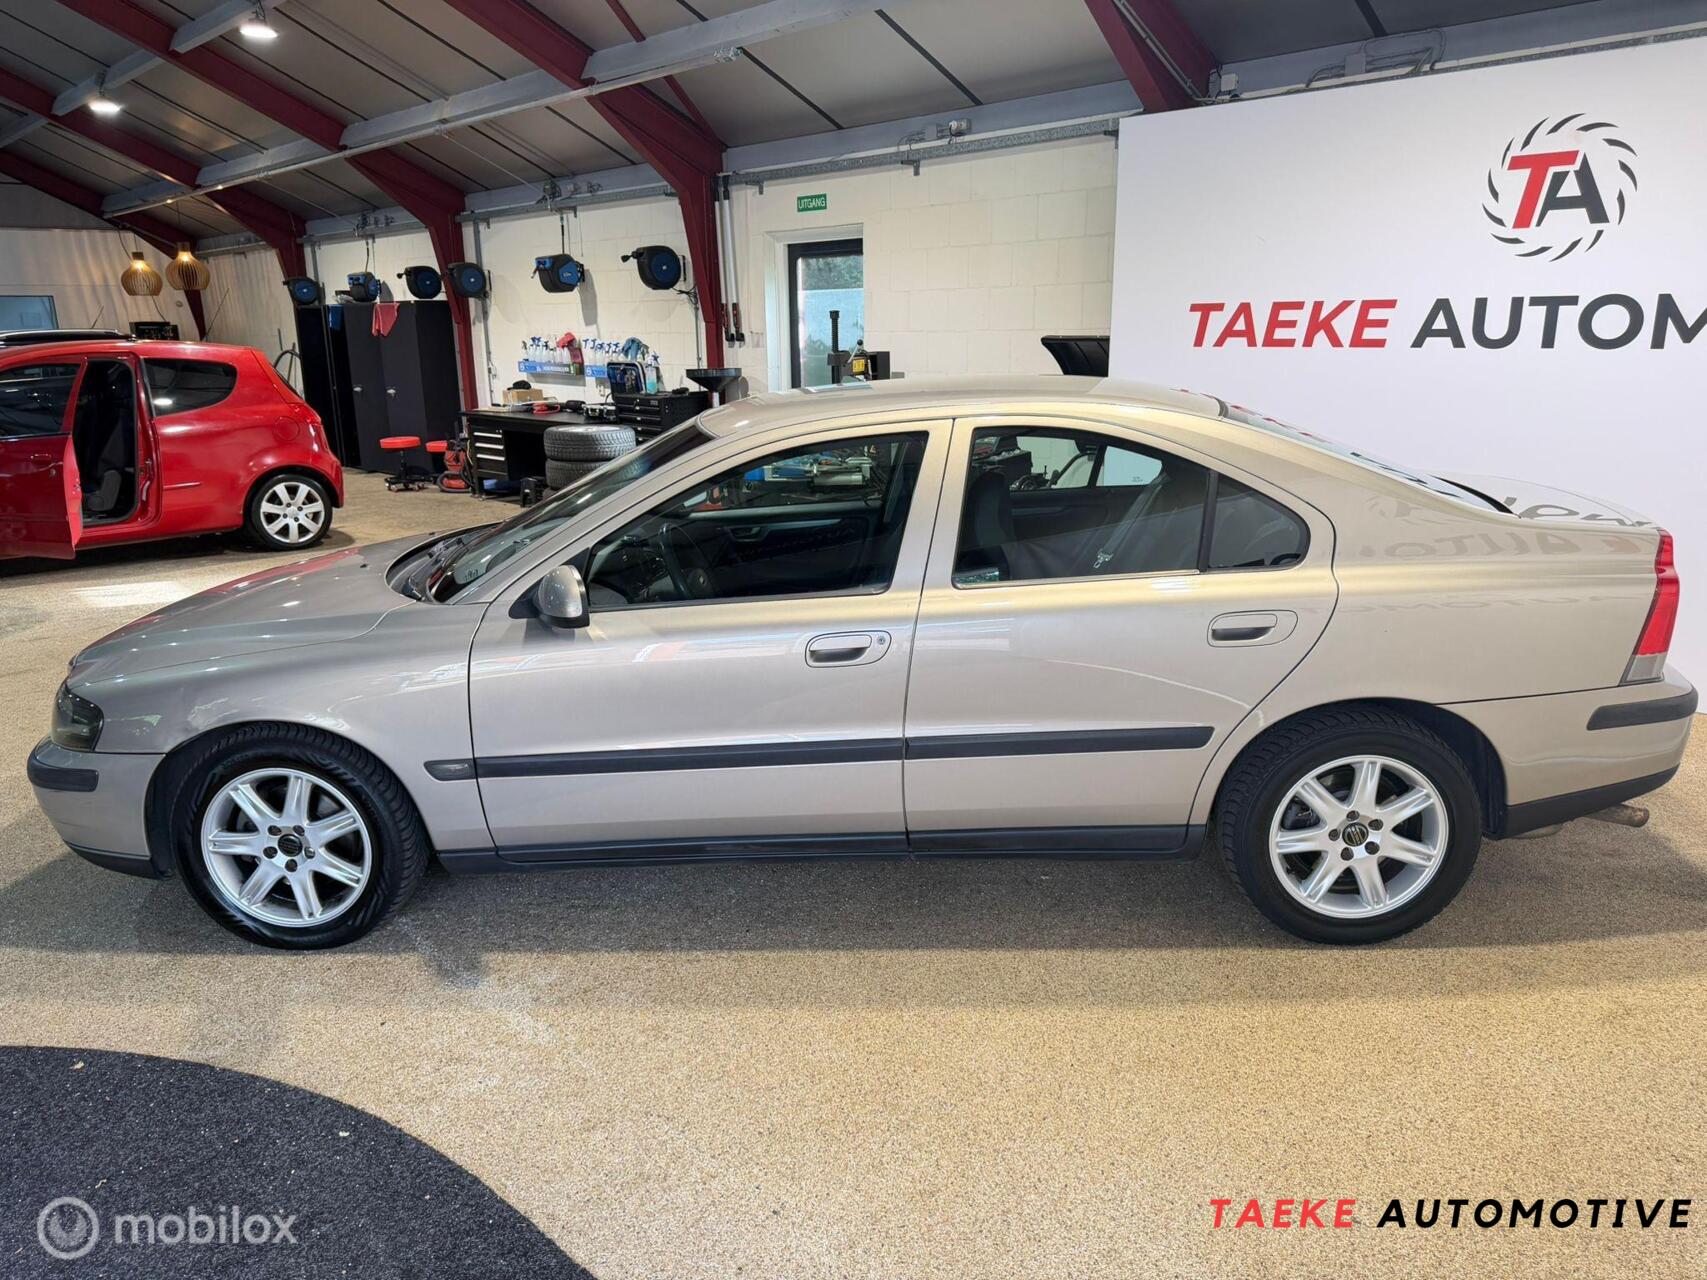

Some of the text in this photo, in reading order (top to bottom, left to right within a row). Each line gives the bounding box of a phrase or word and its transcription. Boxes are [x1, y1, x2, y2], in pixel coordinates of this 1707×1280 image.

[798, 197, 826, 209] UITGANG
[1508, 149, 1610, 229] TA
[1189, 293, 1707, 350] TAEKE AUTOM
